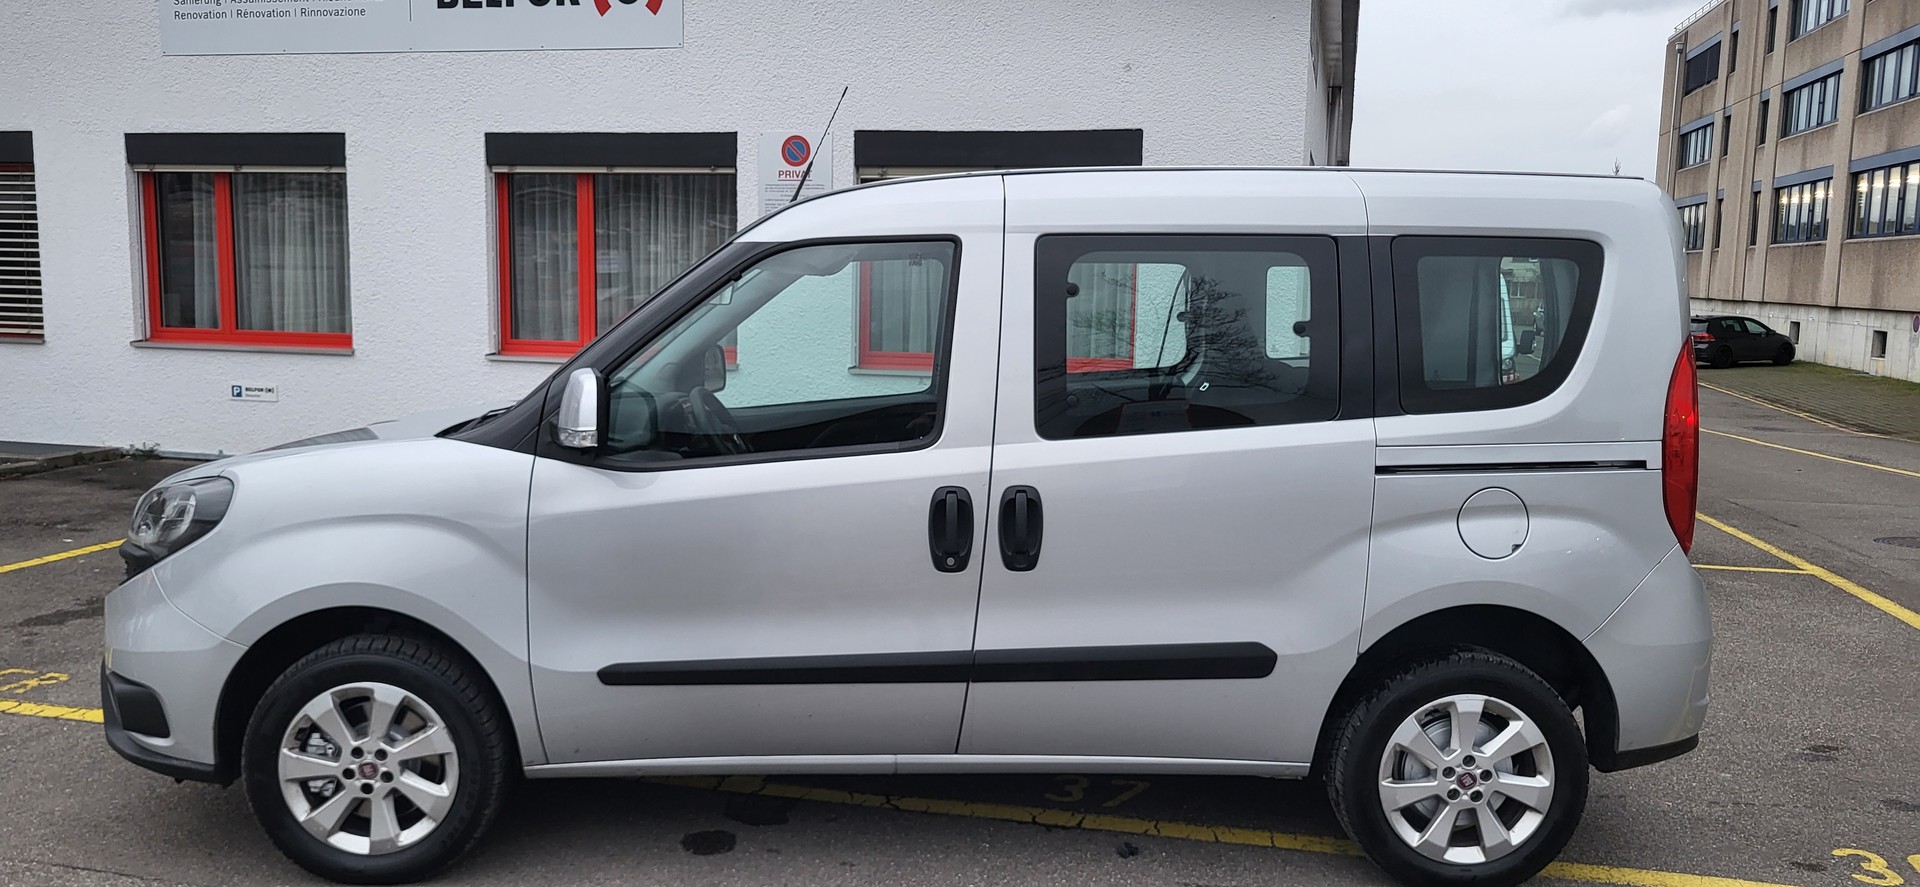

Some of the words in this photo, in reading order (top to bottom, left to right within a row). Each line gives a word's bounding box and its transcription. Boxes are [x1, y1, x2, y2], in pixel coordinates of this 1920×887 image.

[174, 10, 227, 20] Renovation
[236, 8, 291, 19] Rénovation
[300, 7, 366, 17] Rinnovazione
[1044, 775, 1150, 808] 37
[1831, 848, 1920, 886] 3
